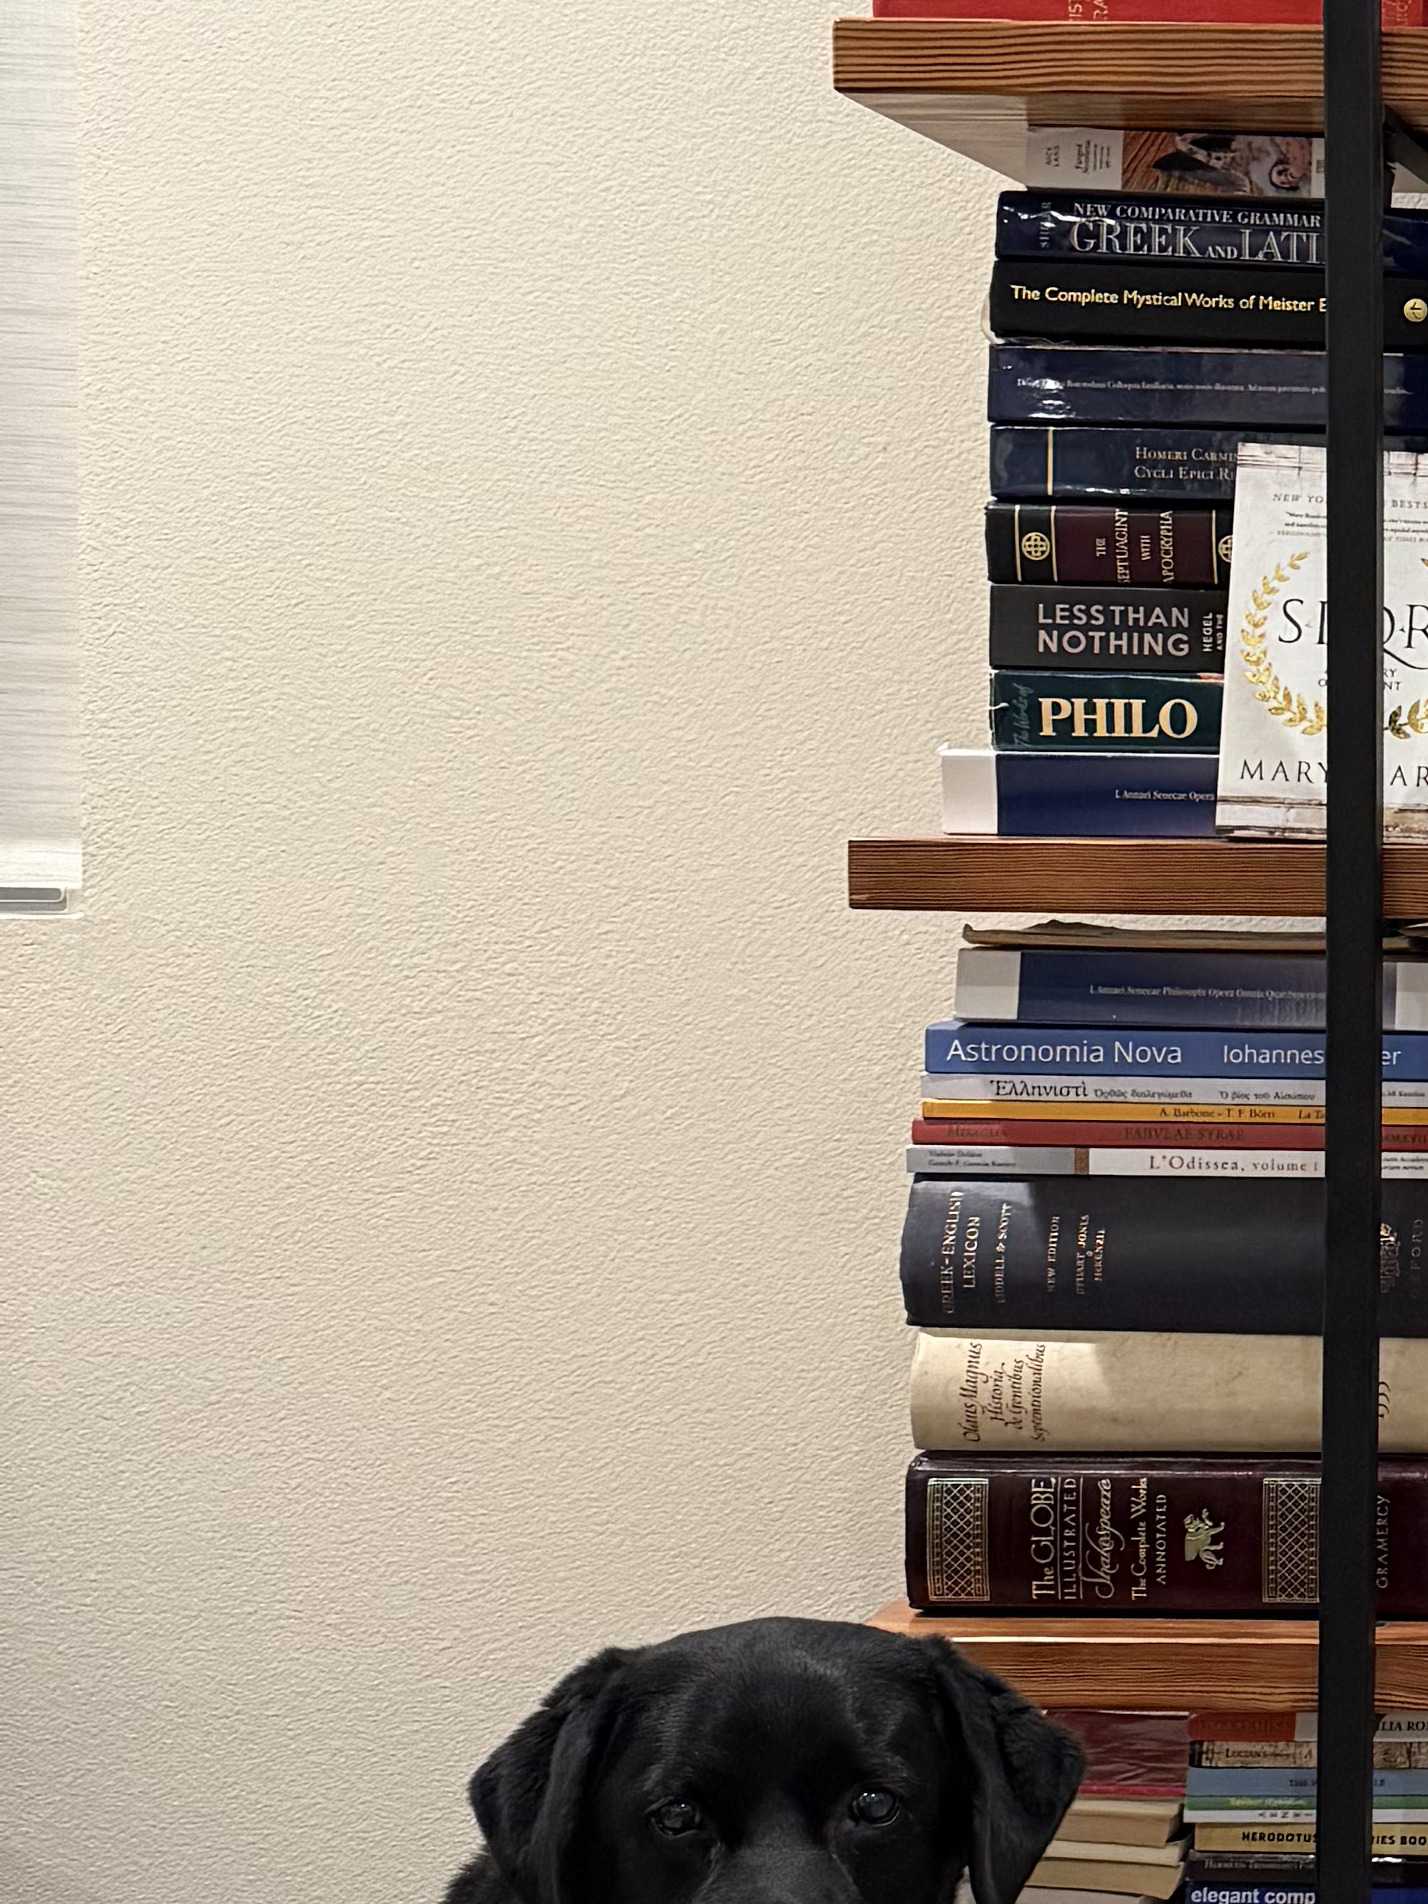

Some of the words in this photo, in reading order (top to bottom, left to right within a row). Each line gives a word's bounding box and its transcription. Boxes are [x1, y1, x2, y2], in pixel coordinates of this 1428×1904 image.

[1038, 604, 1104, 627] LESS
[1110, 605, 1189, 628] THAN
[1037, 630, 1190, 656] NOTHING
[1038, 698, 1198, 738] PHILO
[947, 1040, 1105, 1064] Astronomia
[1114, 1041, 1182, 1064] Nova
[1222, 1044, 1324, 1066] Iohannes
